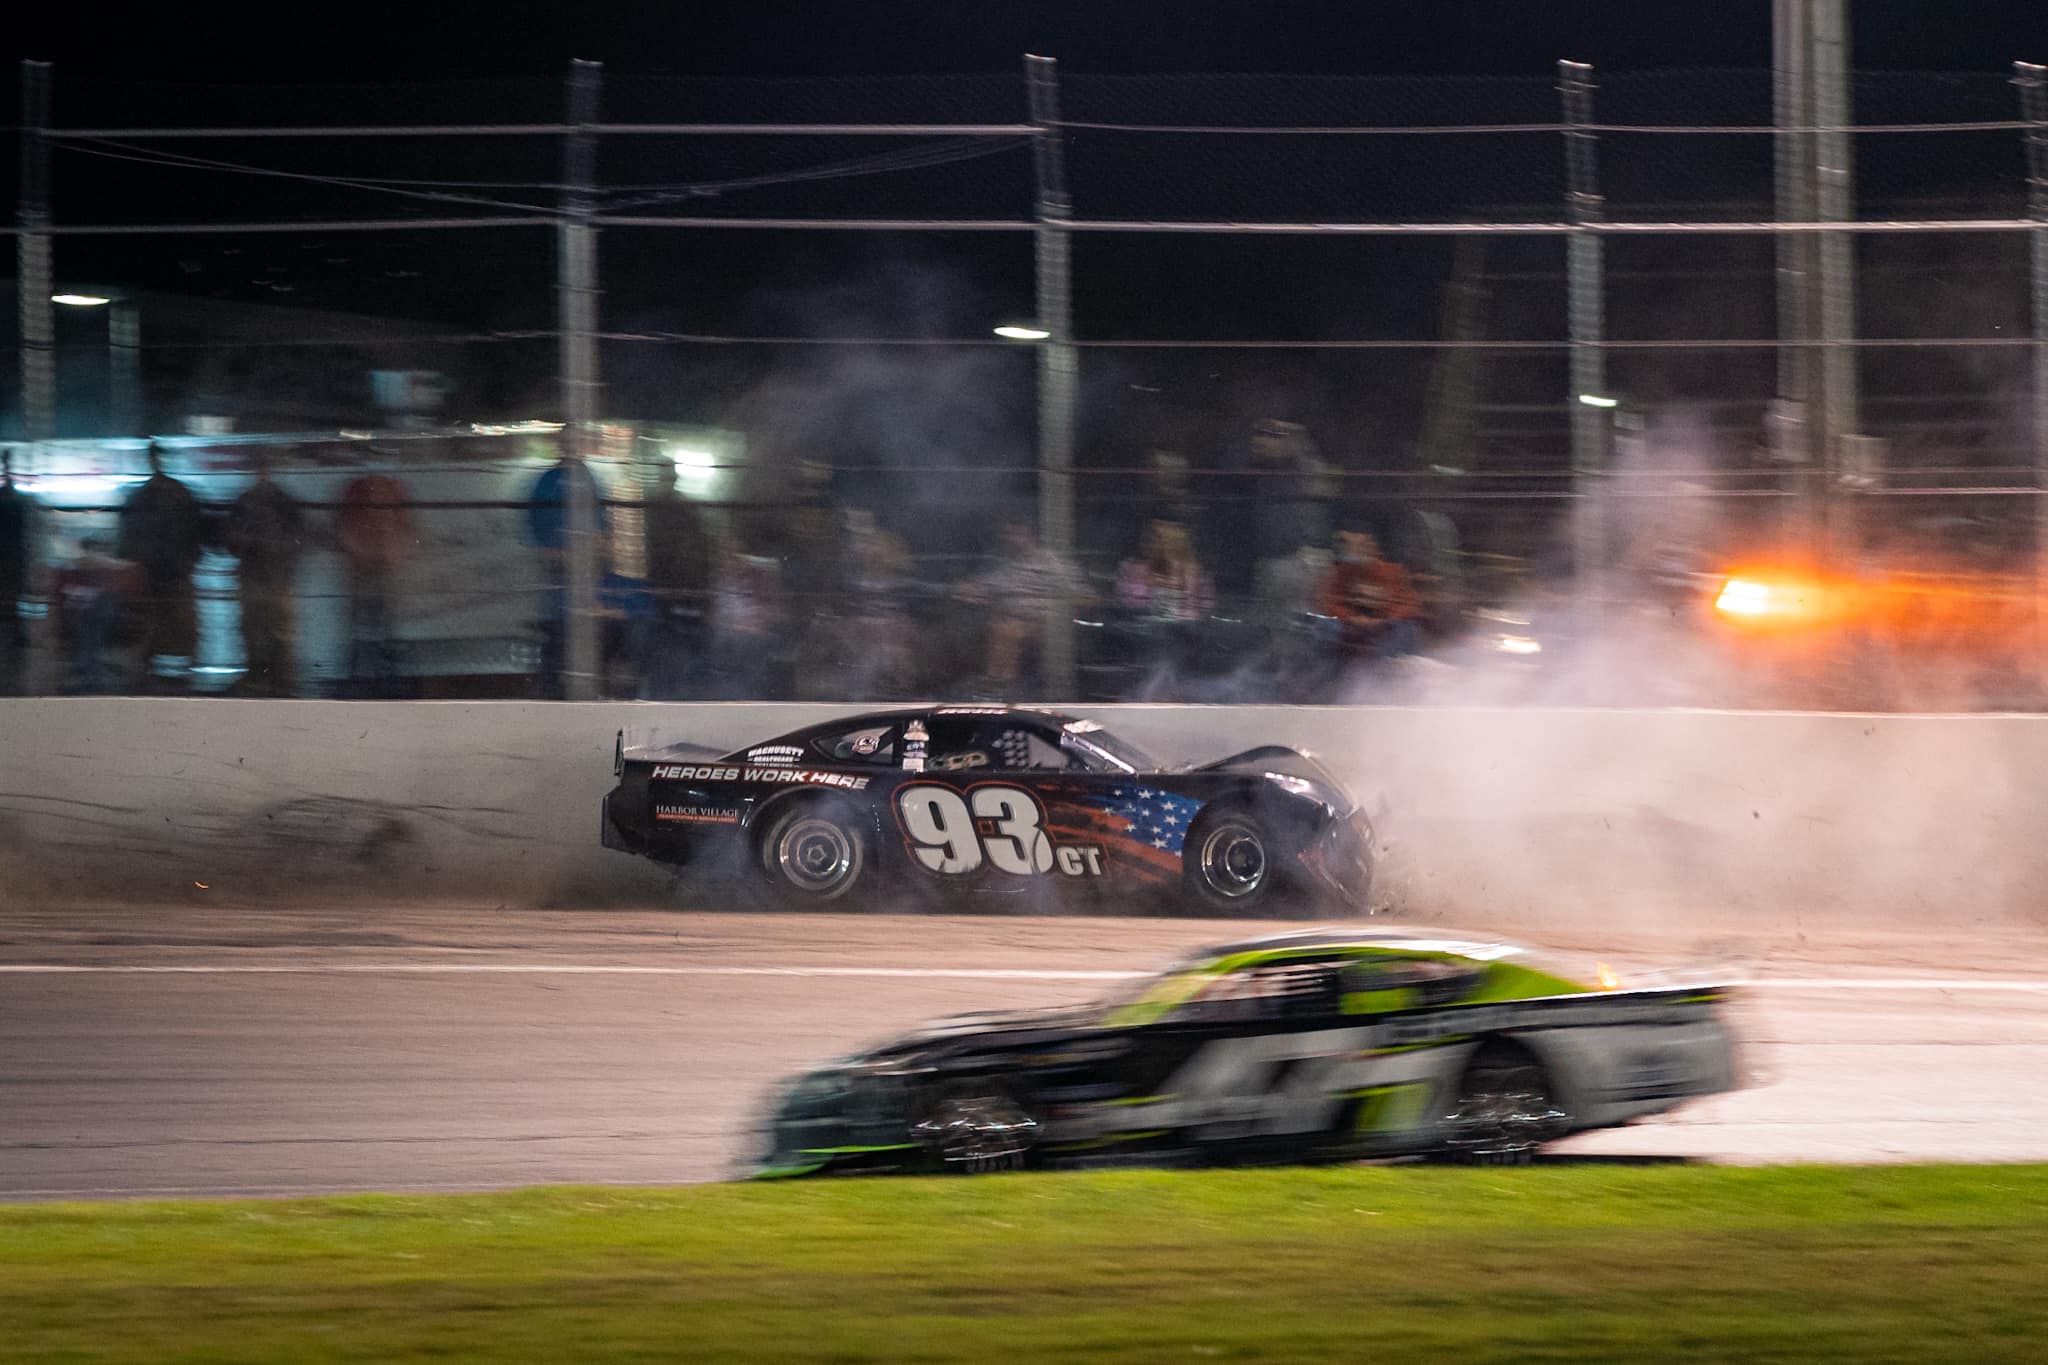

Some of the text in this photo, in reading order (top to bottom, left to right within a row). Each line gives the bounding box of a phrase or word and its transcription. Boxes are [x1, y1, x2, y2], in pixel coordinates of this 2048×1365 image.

[652, 766, 869, 790] HEROES WORK HERE
[656, 805, 698, 816] HARBOR
[700, 807, 739, 818] VILLAGE
[900, 786, 1102, 876] 93 CT
